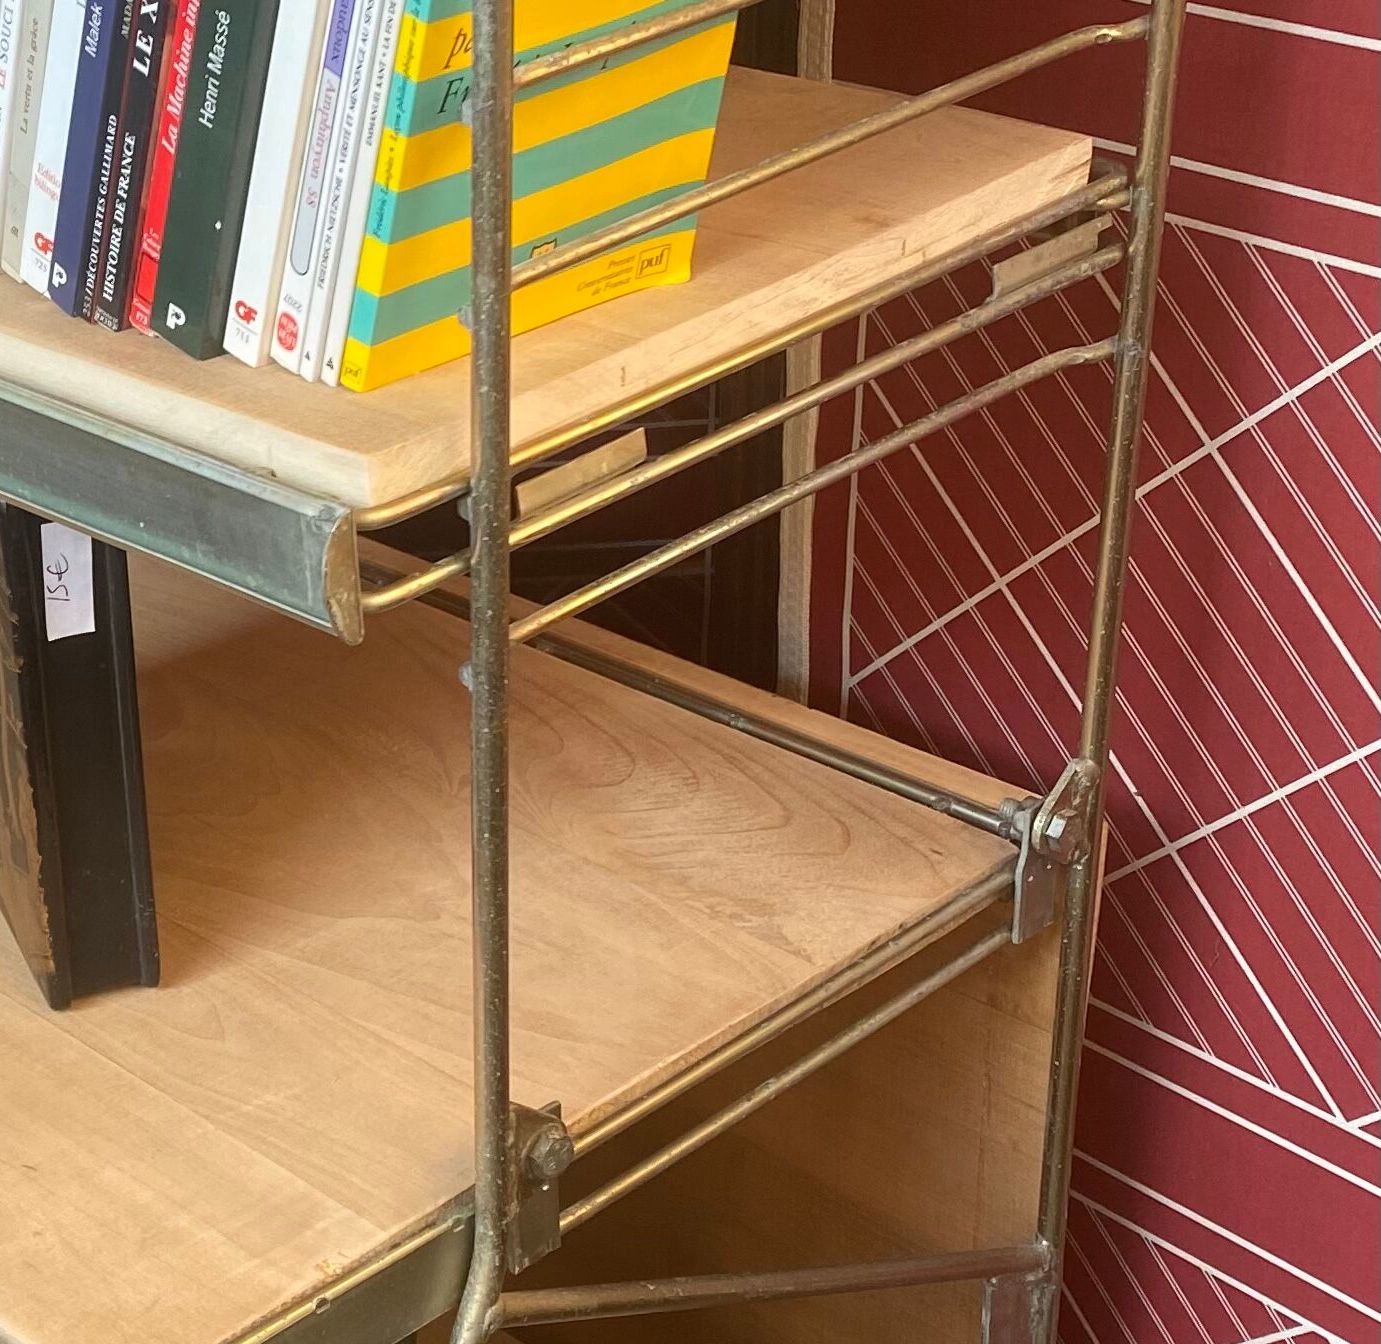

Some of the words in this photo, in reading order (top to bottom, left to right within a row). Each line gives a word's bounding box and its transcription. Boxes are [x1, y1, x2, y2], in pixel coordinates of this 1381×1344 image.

[85, 1, 104, 59] Malek
[133, 29, 154, 79] LE
[206, 10, 231, 71] Massé
[22, 83, 33, 116] vertu
[166, 25, 193, 118] Machine
[20, 117, 28, 136] La
[198, 73, 221, 129] Henri
[99, 114, 118, 195] GALLIMARD
[161, 123, 179, 157] La
[310, 79, 338, 182] Amphitryon
[118, 132, 136, 199] FRANCE
[113, 198, 126, 227] DE
[102, 228, 124, 303] HISTOIRE
[638, 246, 670, 275] puf
